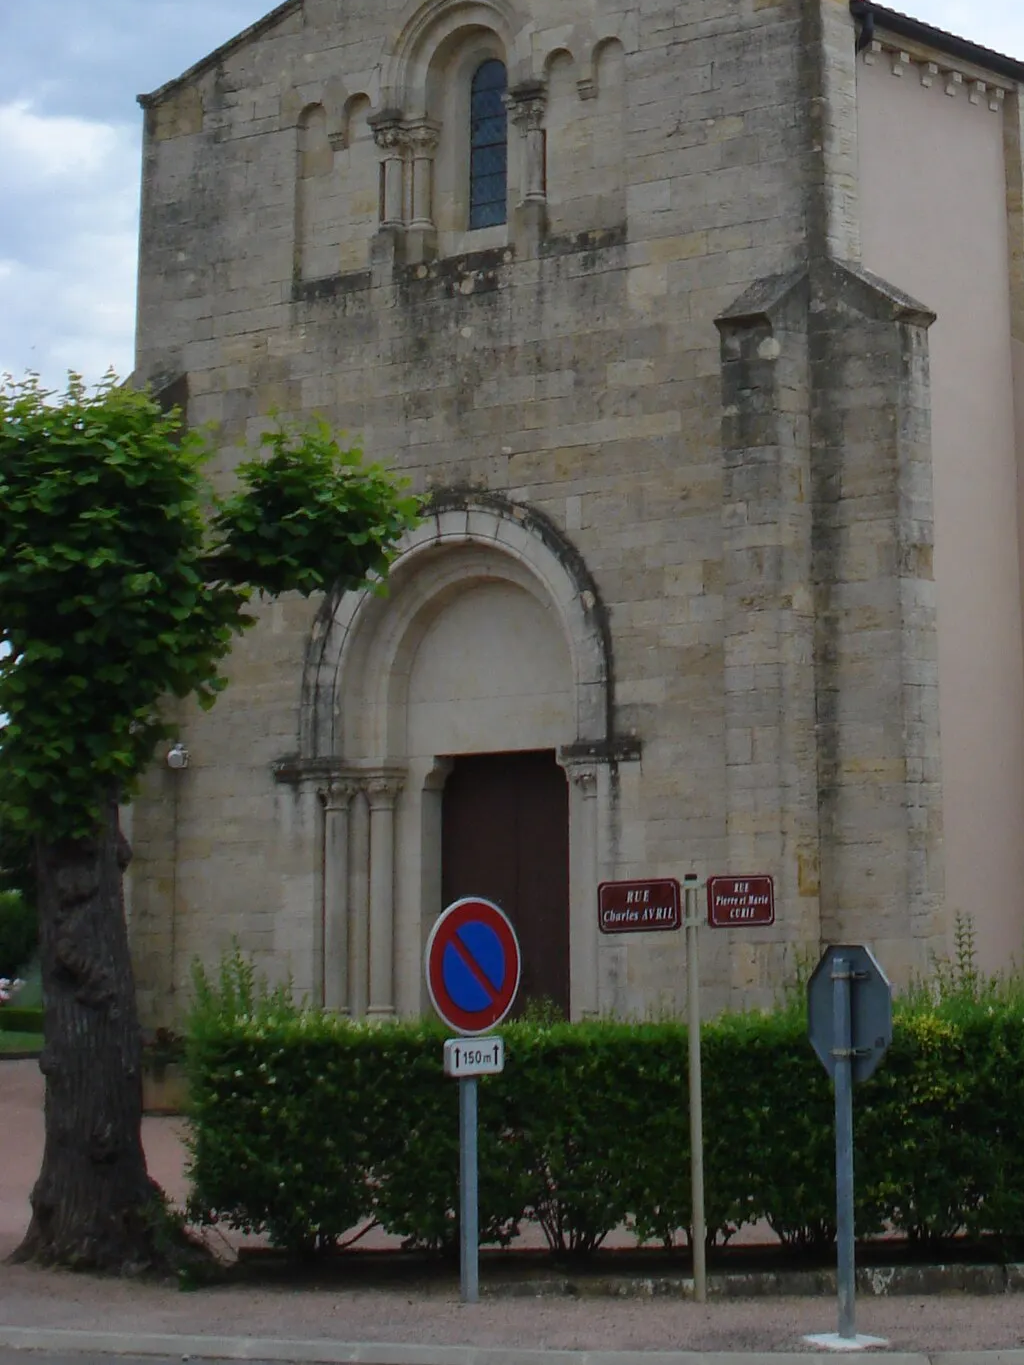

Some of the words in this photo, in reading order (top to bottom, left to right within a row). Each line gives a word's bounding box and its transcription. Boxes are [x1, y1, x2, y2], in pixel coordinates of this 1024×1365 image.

[734, 882, 749, 893] RUE
[626, 889, 650, 903] RUE
[716, 895, 738, 906] Pierre
[748, 895, 768, 905] Marie
[603, 908, 639, 923] Charles
[642, 907, 674, 921] AVRIL
[729, 907, 755, 919] CURIE
